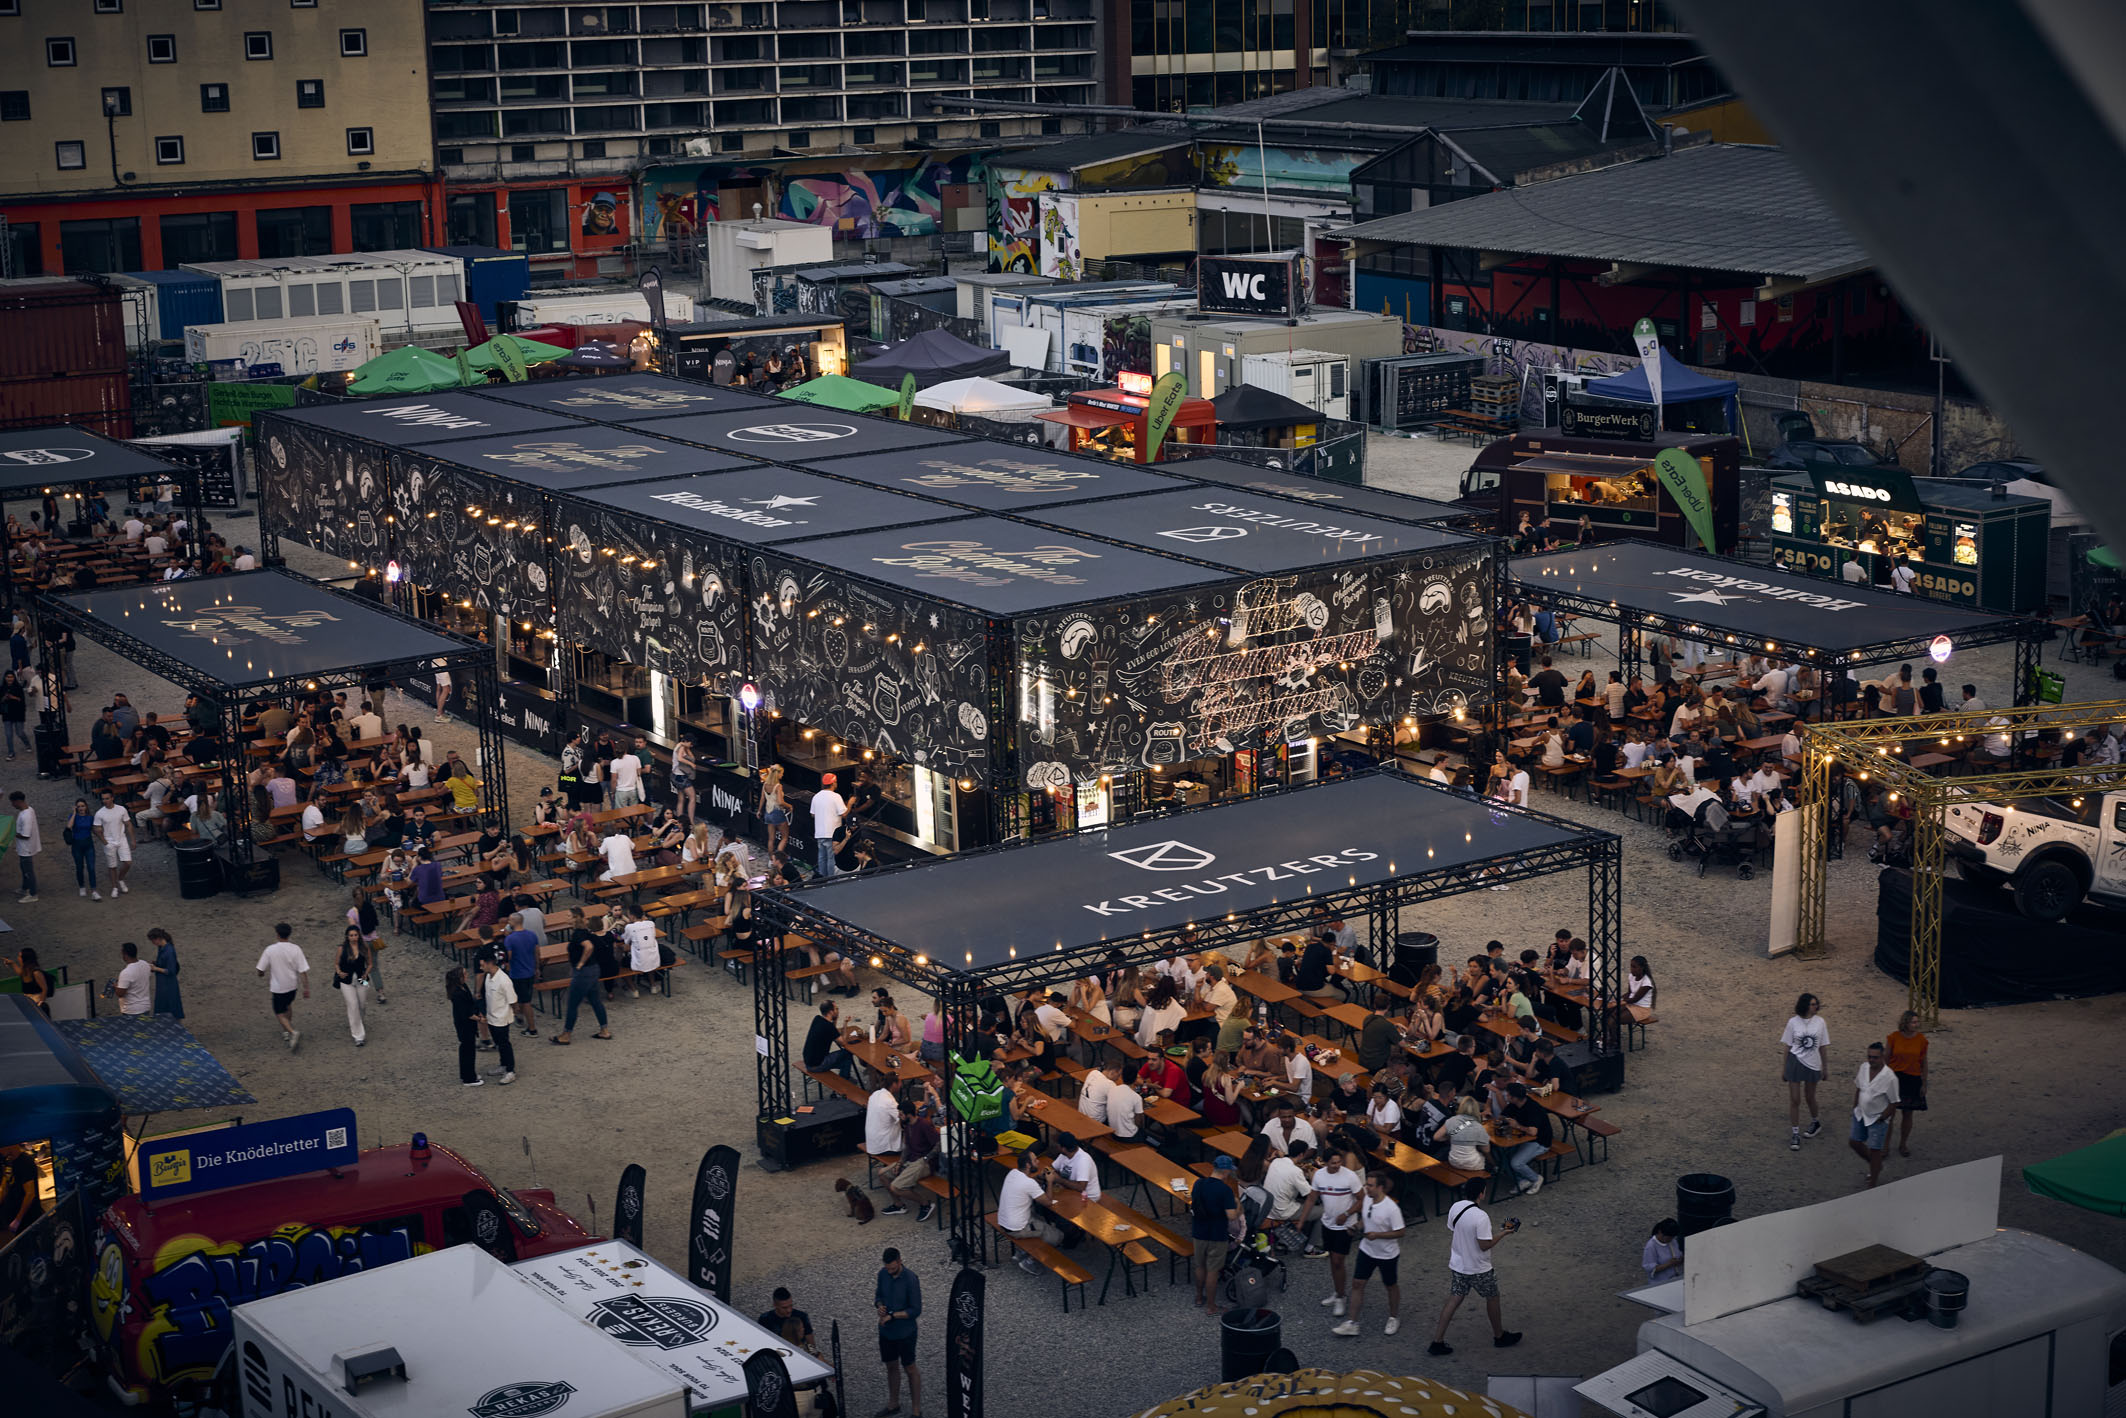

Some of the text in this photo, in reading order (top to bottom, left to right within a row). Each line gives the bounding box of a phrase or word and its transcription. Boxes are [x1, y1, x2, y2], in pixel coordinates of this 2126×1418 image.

[1222, 271, 1266, 300] WC
[715, 359, 732, 367] NINJA
[361, 404, 477, 429] NINJA
[1152, 382, 1183, 430] Uber Eats
[1577, 412, 1639, 426] BurgerWerk
[1825, 480, 1892, 502] ASADO
[649, 491, 793, 528] Heineken
[1191, 502, 1385, 543] KREUTZERS
[994, 545, 1101, 565] The
[1451, 548, 1491, 579] NINJA
[872, 554, 1015, 587] Burger
[1339, 571, 1354, 589] The
[1332, 573, 1368, 607] Champions
[1343, 584, 1367, 610] Burger
[1667, 567, 1869, 611] Heineken
[261, 609, 342, 627] The
[1126, 657, 1146, 671] EVEN
[1146, 647, 1160, 660] GOD
[1160, 635, 1182, 653] LOVES
[1448, 671, 1489, 688] KREUTZERS
[524, 707, 550, 738] NINJA
[712, 784, 742, 818] NINJA
[2026, 821, 2051, 837] NINJA
[1082, 847, 1379, 916] KREUTZERS
[980, 1109, 999, 1117] Eats
[196, 1135, 321, 1170] Die Knödelretter
[530, 1271, 545, 1282] SOUL
[575, 1257, 625, 1288] 2022 2023 2024
[543, 1280, 557, 1292] YOUR
[622, 1306, 679, 1337] REKAS
[655, 1302, 699, 1328] BURGERS
[713, 1346, 734, 1357] 2024
[668, 1363, 685, 1374] SOUL
[685, 1372, 702, 1385] YOUR
[495, 1390, 551, 1411] REKAS
